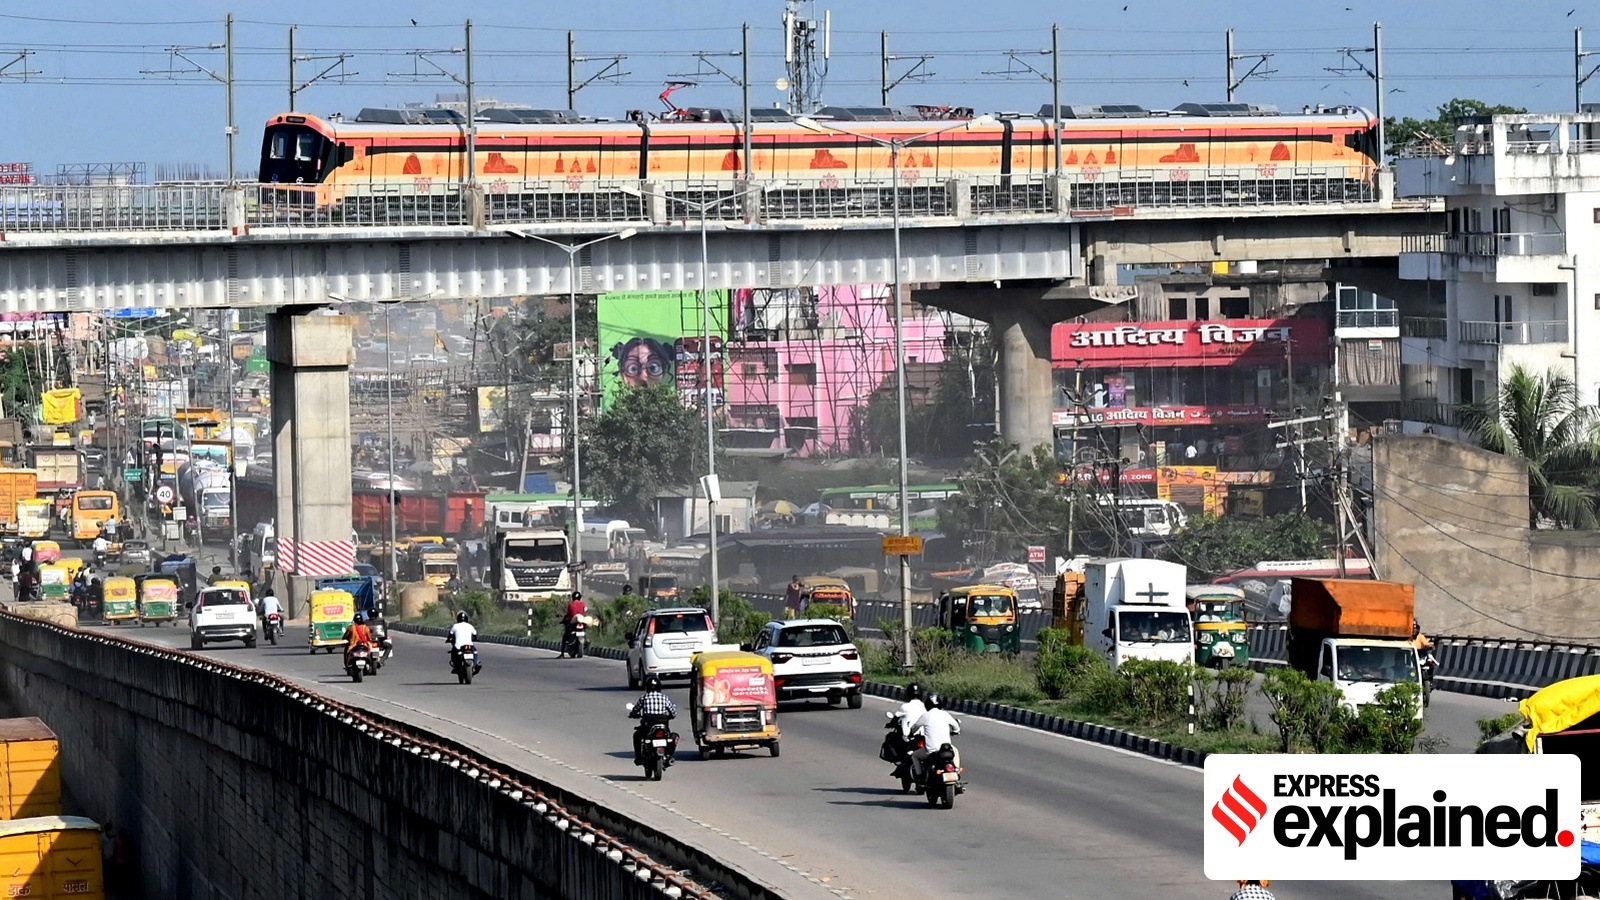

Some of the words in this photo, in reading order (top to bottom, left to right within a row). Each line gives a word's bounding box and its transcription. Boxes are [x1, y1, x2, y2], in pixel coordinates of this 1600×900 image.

[1071, 325, 1188, 347] आदित्य
[1198, 323, 1293, 343] विजन
[1092, 413, 1104, 422] LG
[1106, 408, 1148, 421] आदित्य
[1152, 407, 1185, 419] विजन
[160, 490, 171, 499] 40
